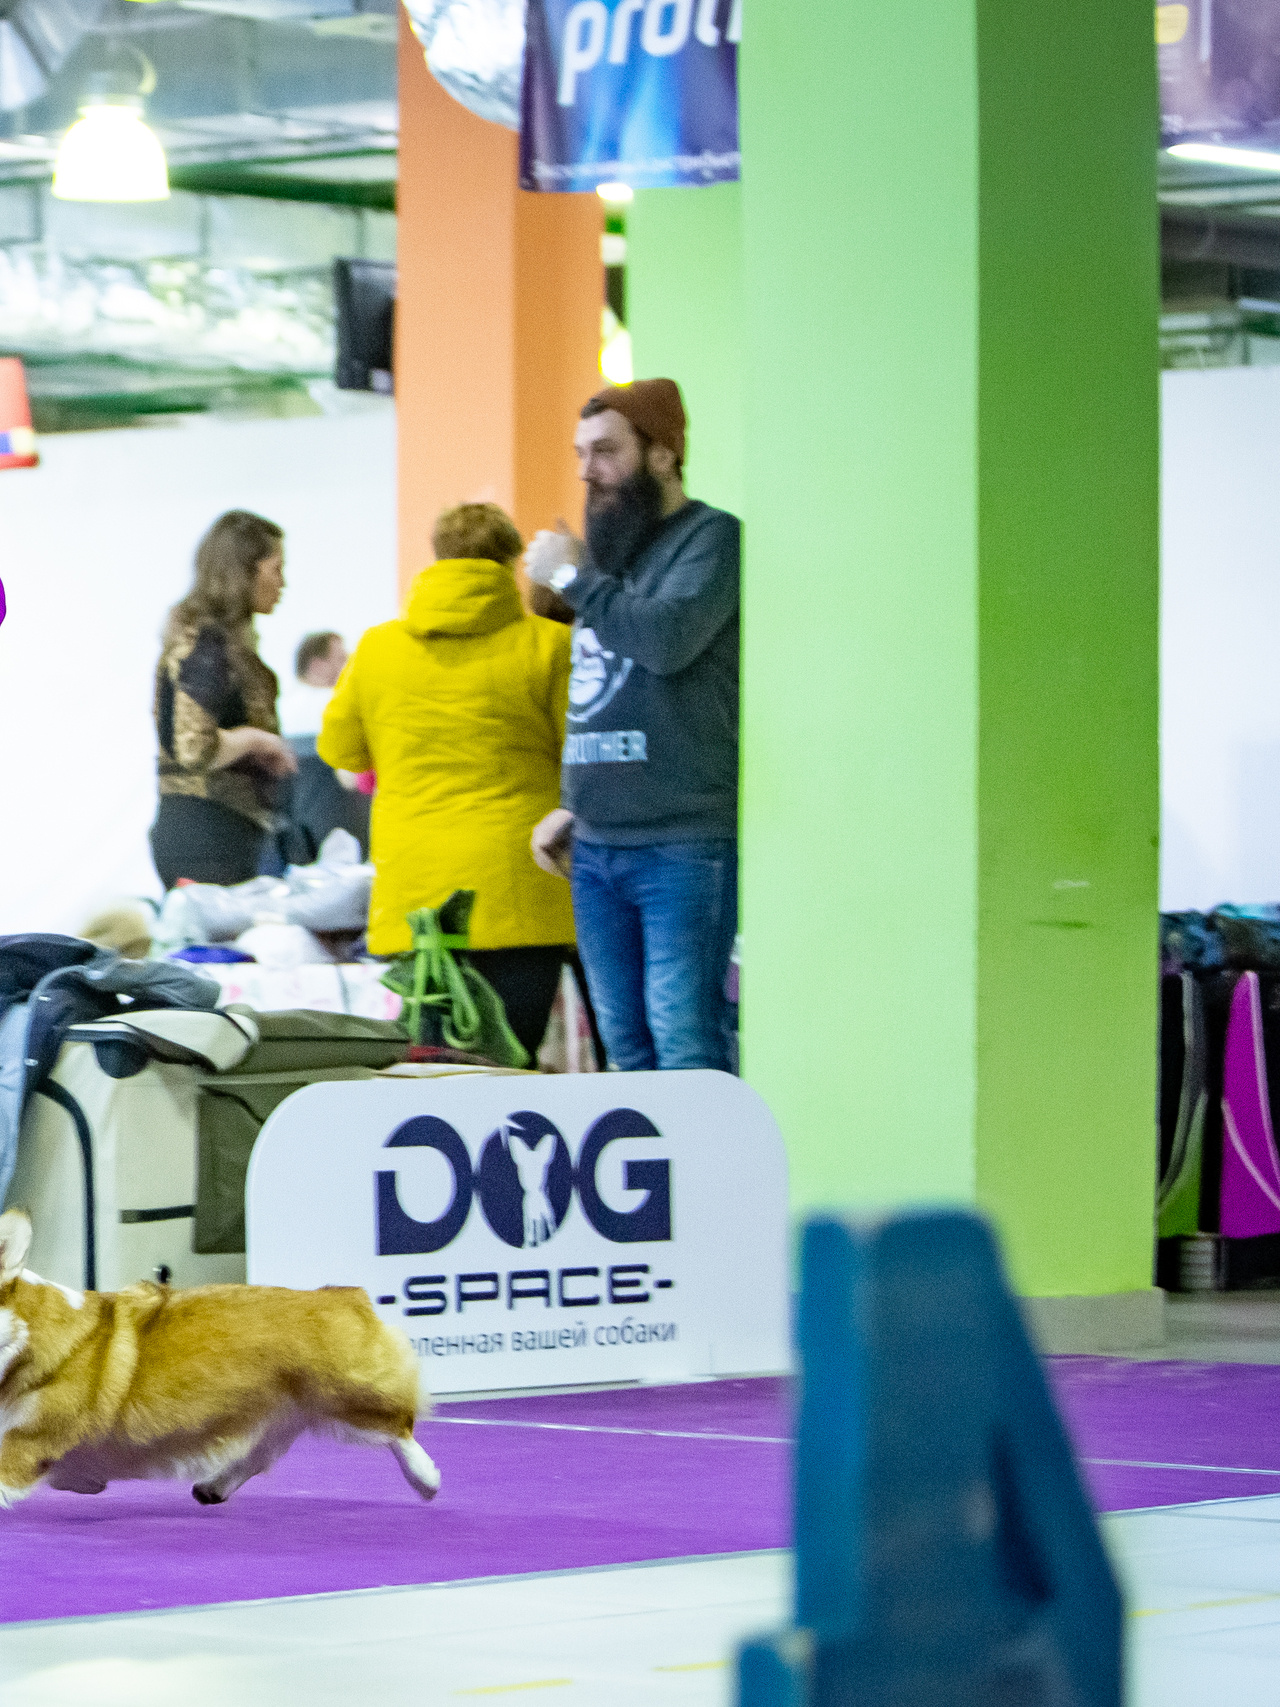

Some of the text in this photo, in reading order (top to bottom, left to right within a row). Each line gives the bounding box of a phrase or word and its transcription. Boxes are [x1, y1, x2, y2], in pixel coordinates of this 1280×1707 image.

[373, 1106, 673, 1256] DOG
[511, 1320, 587, 1351] вашей
[593, 1316, 677, 1346] собаки
